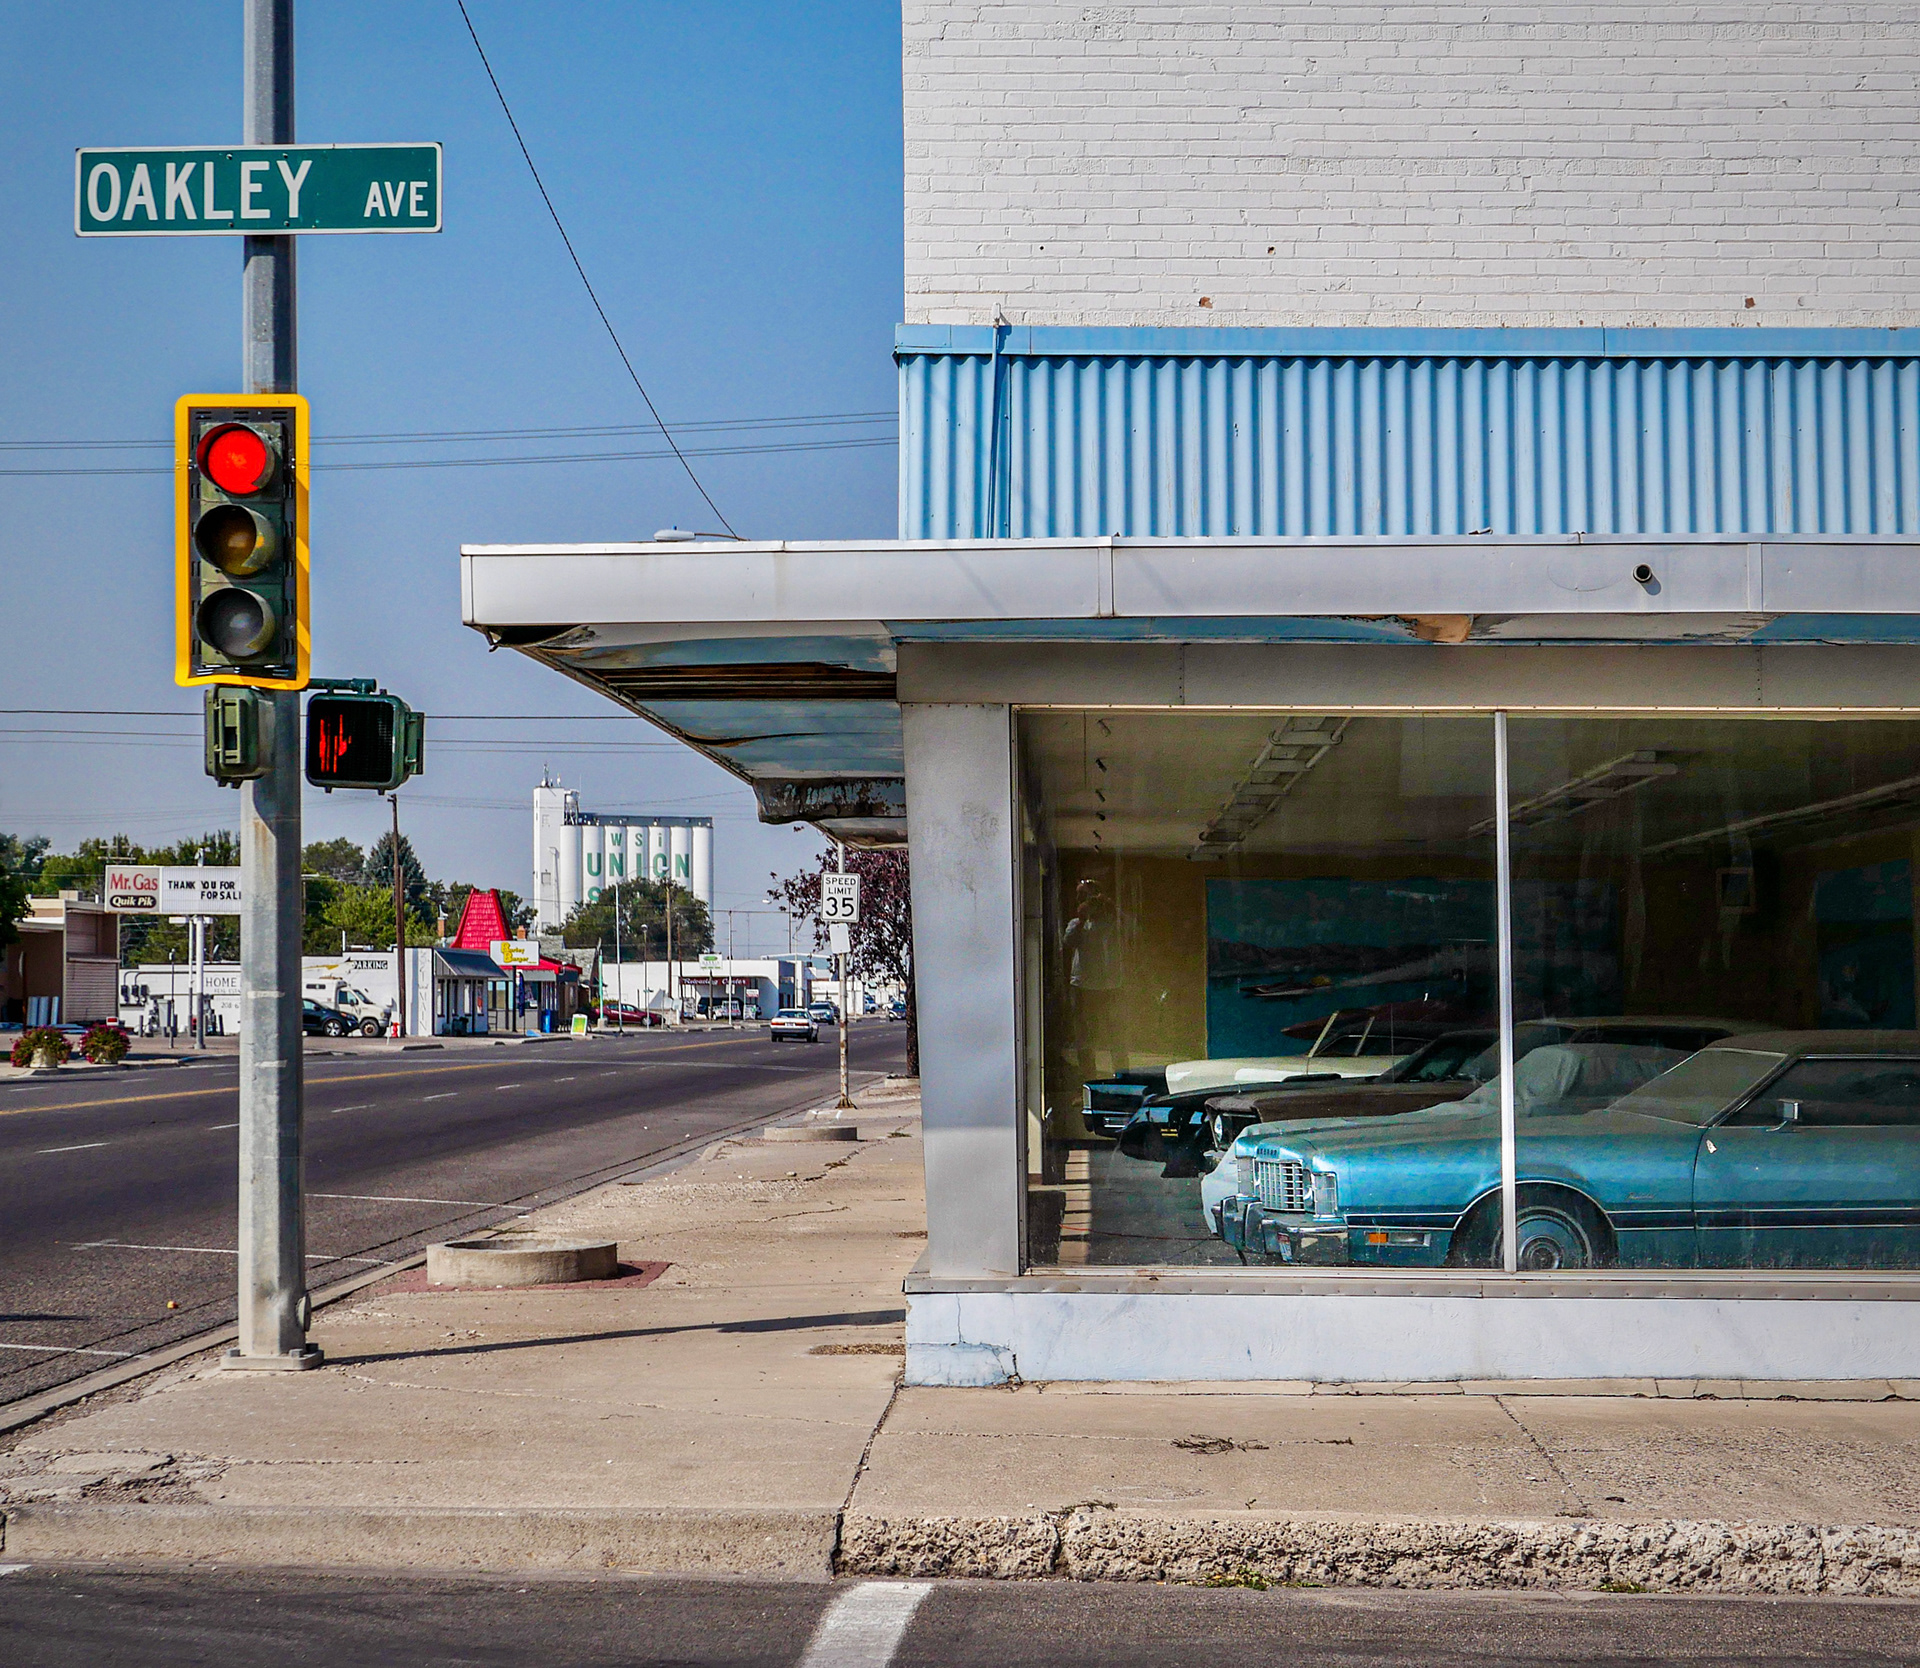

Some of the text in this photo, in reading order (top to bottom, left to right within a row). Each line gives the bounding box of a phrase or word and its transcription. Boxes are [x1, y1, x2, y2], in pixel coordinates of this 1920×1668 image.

[87, 160, 429, 222] OAKLEY AVE
[587, 852, 690, 878] UNION
[110, 873, 158, 891] Mr. Gas
[167, 880, 235, 890] THANK YOU FOR
[825, 876, 857, 886] SPEED
[828, 887, 853, 895] LIMIT
[111, 896, 154, 907] Quik Pik
[825, 896, 855, 917] 35
[503, 951, 529, 963] Burger
[351, 960, 388, 970] PARKING
[205, 977, 237, 988] HOME
